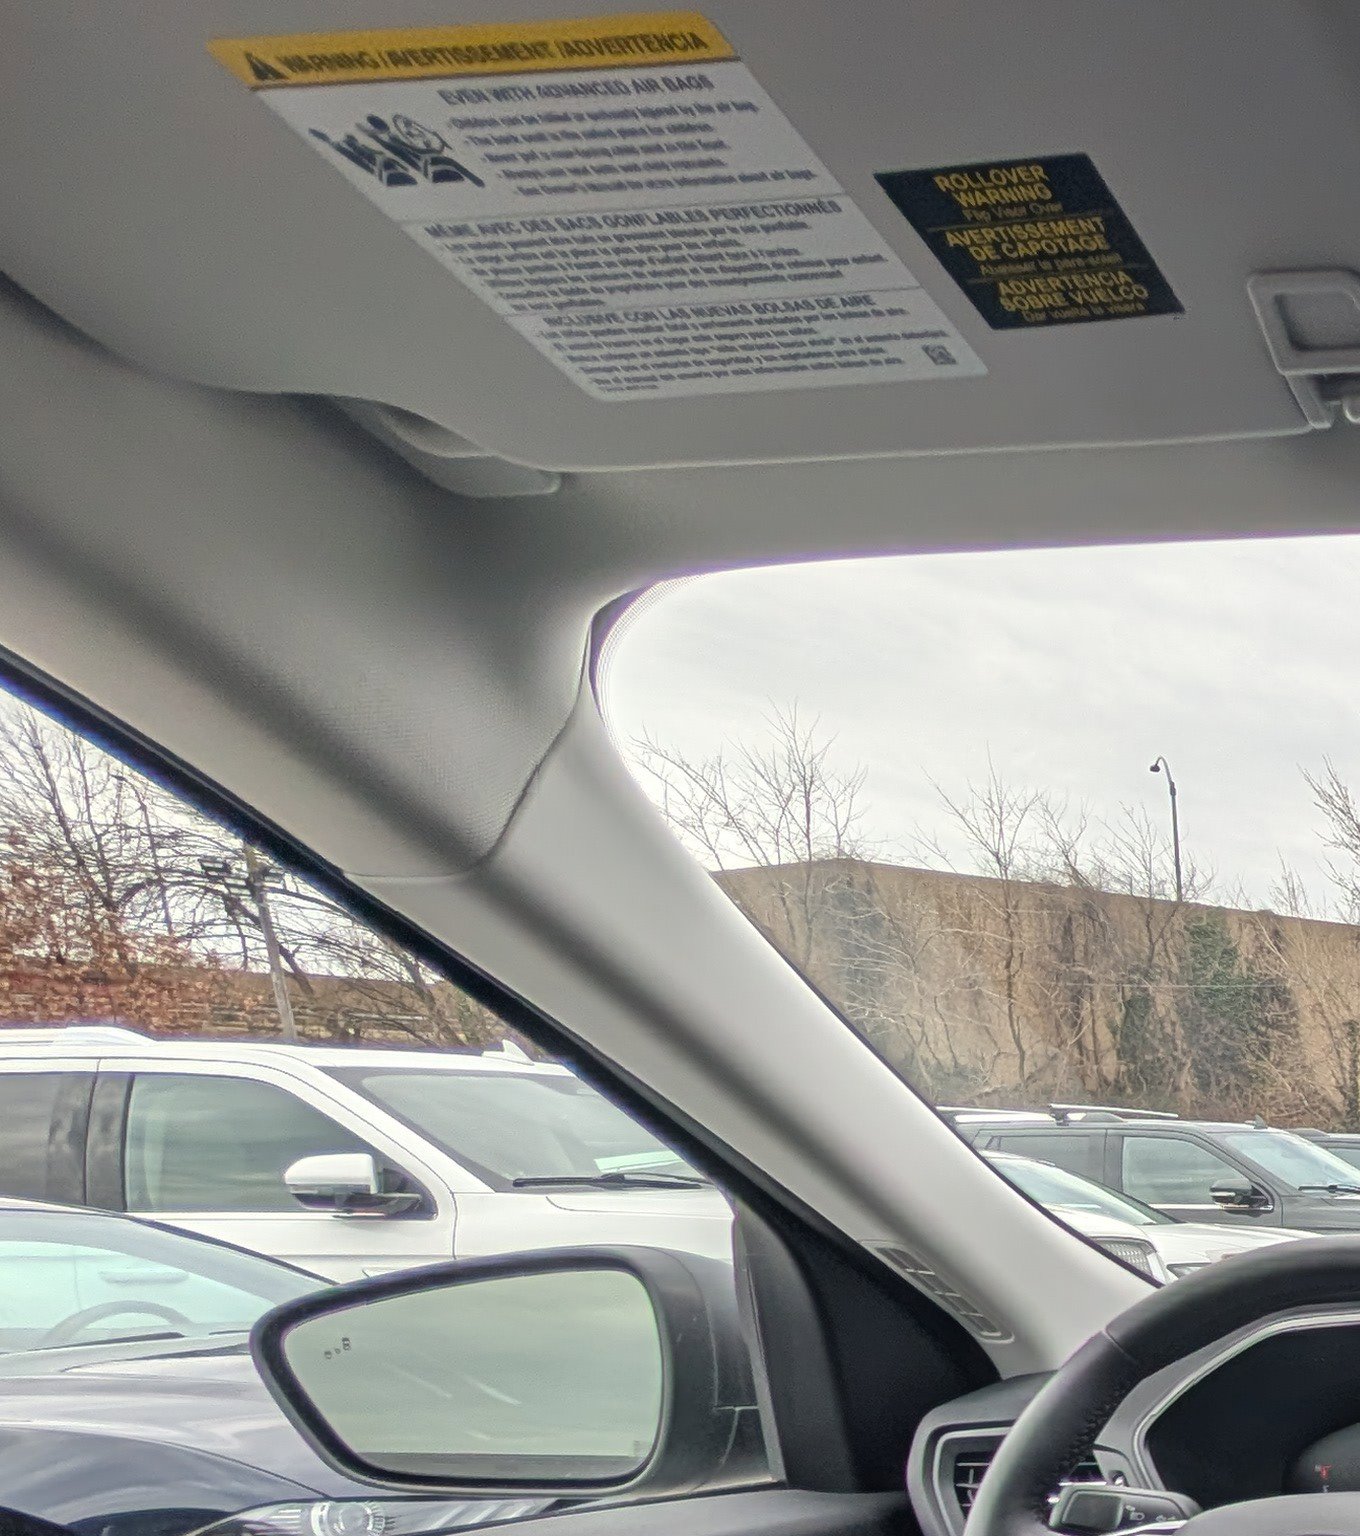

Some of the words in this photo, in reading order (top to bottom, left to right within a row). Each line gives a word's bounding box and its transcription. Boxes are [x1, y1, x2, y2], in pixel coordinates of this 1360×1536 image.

[439, 89, 488, 104] EVEN
[488, 86, 534, 101] WITH
[534, 80, 629, 98] ADVANCED
[628, 78, 661, 92] AIR
[662, 75, 712, 90] BAGS
[934, 166, 1049, 192] ROLLOVER
[954, 184, 1052, 207] WARNING
[945, 218, 1106, 247] AVERTISSEMENT
[970, 245, 1000, 261] DE
[1004, 235, 1110, 258] CAPOTAGE
[997, 270, 1132, 296] ADVERTENCIA
[999, 293, 1066, 313] SOBRE
[1069, 284, 1150, 306] VUELCO
